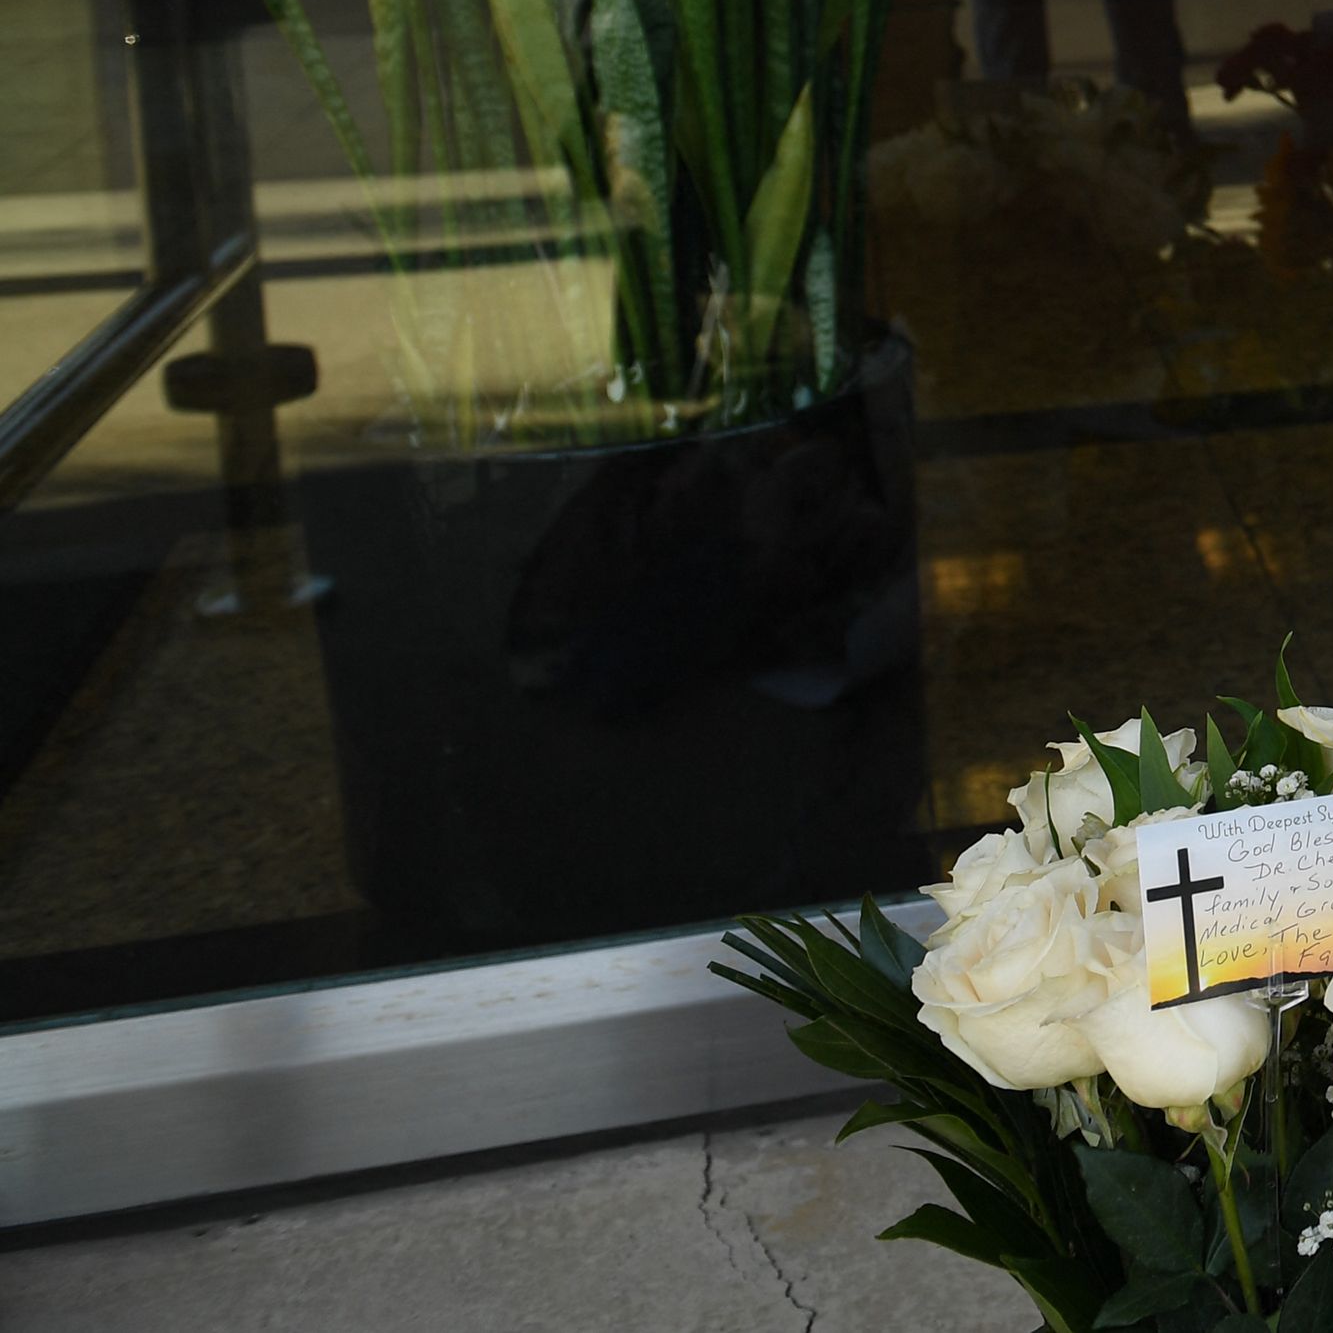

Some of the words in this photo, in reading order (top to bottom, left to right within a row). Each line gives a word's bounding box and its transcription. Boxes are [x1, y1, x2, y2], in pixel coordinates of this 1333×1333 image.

[1198, 818, 1244, 840] With
[1247, 810, 1313, 832] Deepest
[1228, 833, 1276, 863] God
[1204, 886, 1280, 914] family
[1199, 905, 1284, 945] Medical
[1199, 942, 1268, 968] Love,
[1268, 923, 1332, 944] The
